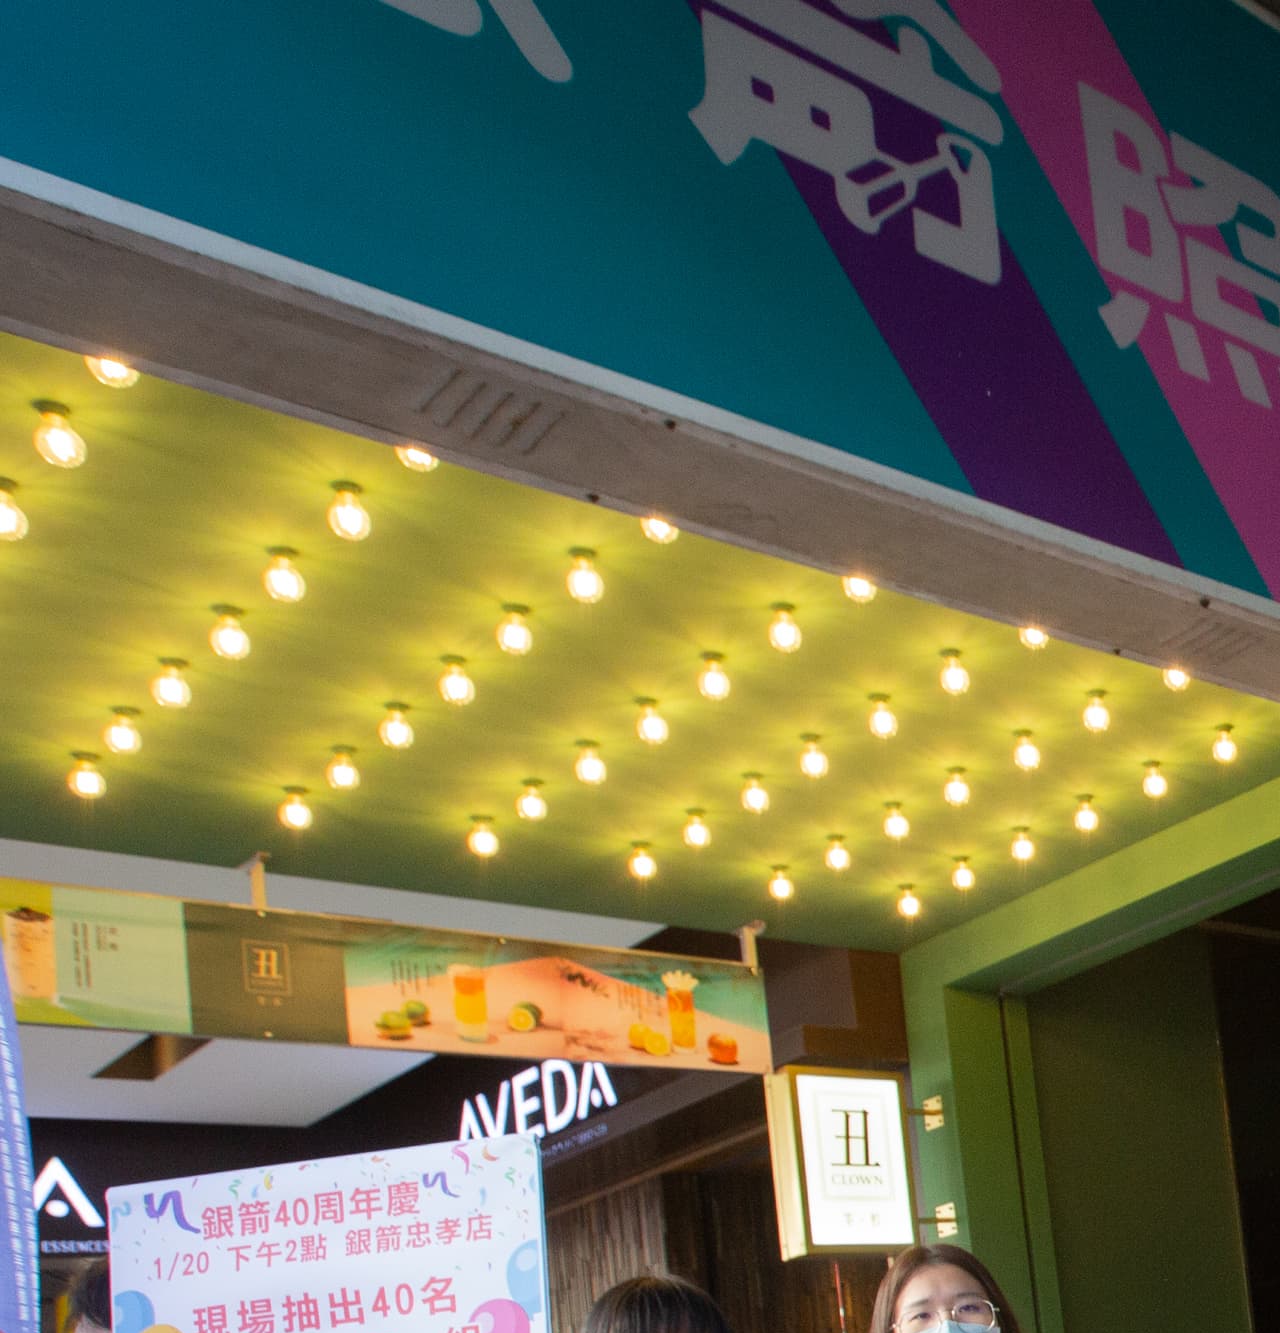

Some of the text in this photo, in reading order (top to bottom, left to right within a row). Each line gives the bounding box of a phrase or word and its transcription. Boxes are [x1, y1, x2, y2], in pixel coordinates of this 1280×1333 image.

[459, 1059, 618, 1142] AVEDA
[832, 1109, 880, 1166] 丑
[832, 1173, 883, 1186] CLOWN
[200, 1181, 422, 1241] 銀箭40周年慶
[152, 1211, 493, 1281] 1/20 下午2點 銀箭忠孝店
